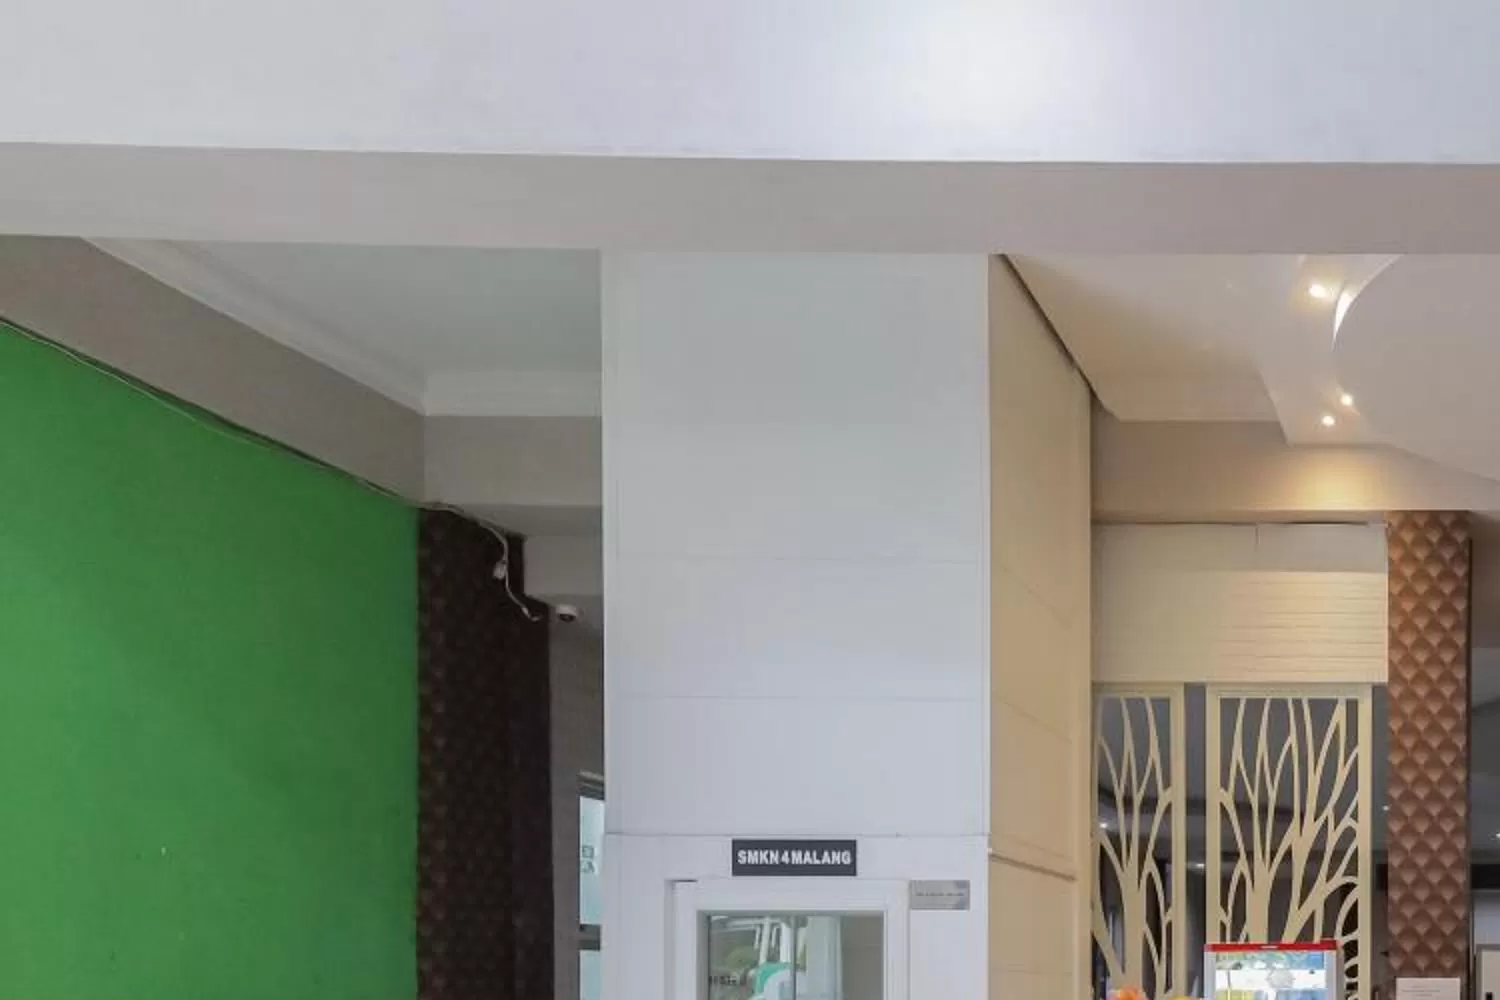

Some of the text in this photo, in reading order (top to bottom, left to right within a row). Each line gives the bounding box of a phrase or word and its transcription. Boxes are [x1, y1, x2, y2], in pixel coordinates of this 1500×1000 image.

[737, 850, 851, 865] SMKN 4 MALANG
